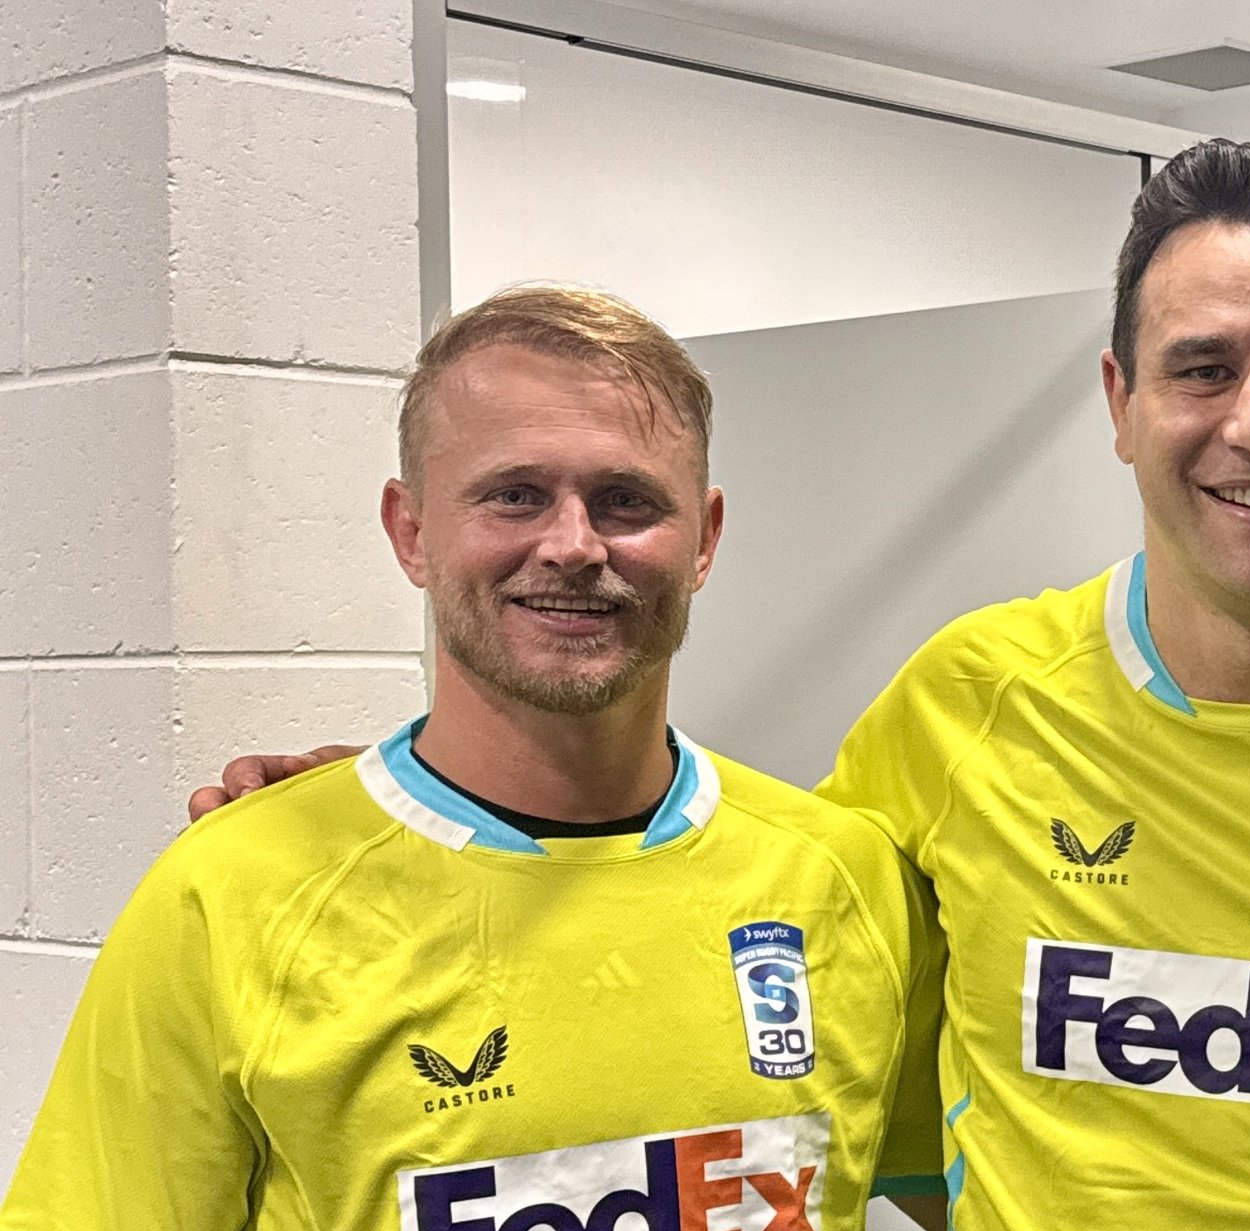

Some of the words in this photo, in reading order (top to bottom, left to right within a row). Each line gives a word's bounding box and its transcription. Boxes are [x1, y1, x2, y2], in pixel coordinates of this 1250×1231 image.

[1050, 869, 1129, 886] CASTORE
[752, 926, 790, 942] swyftx
[758, 1028, 806, 1056] 30
[763, 1061, 806, 1077] YEARS
[424, 1084, 516, 1113] CASTORE
